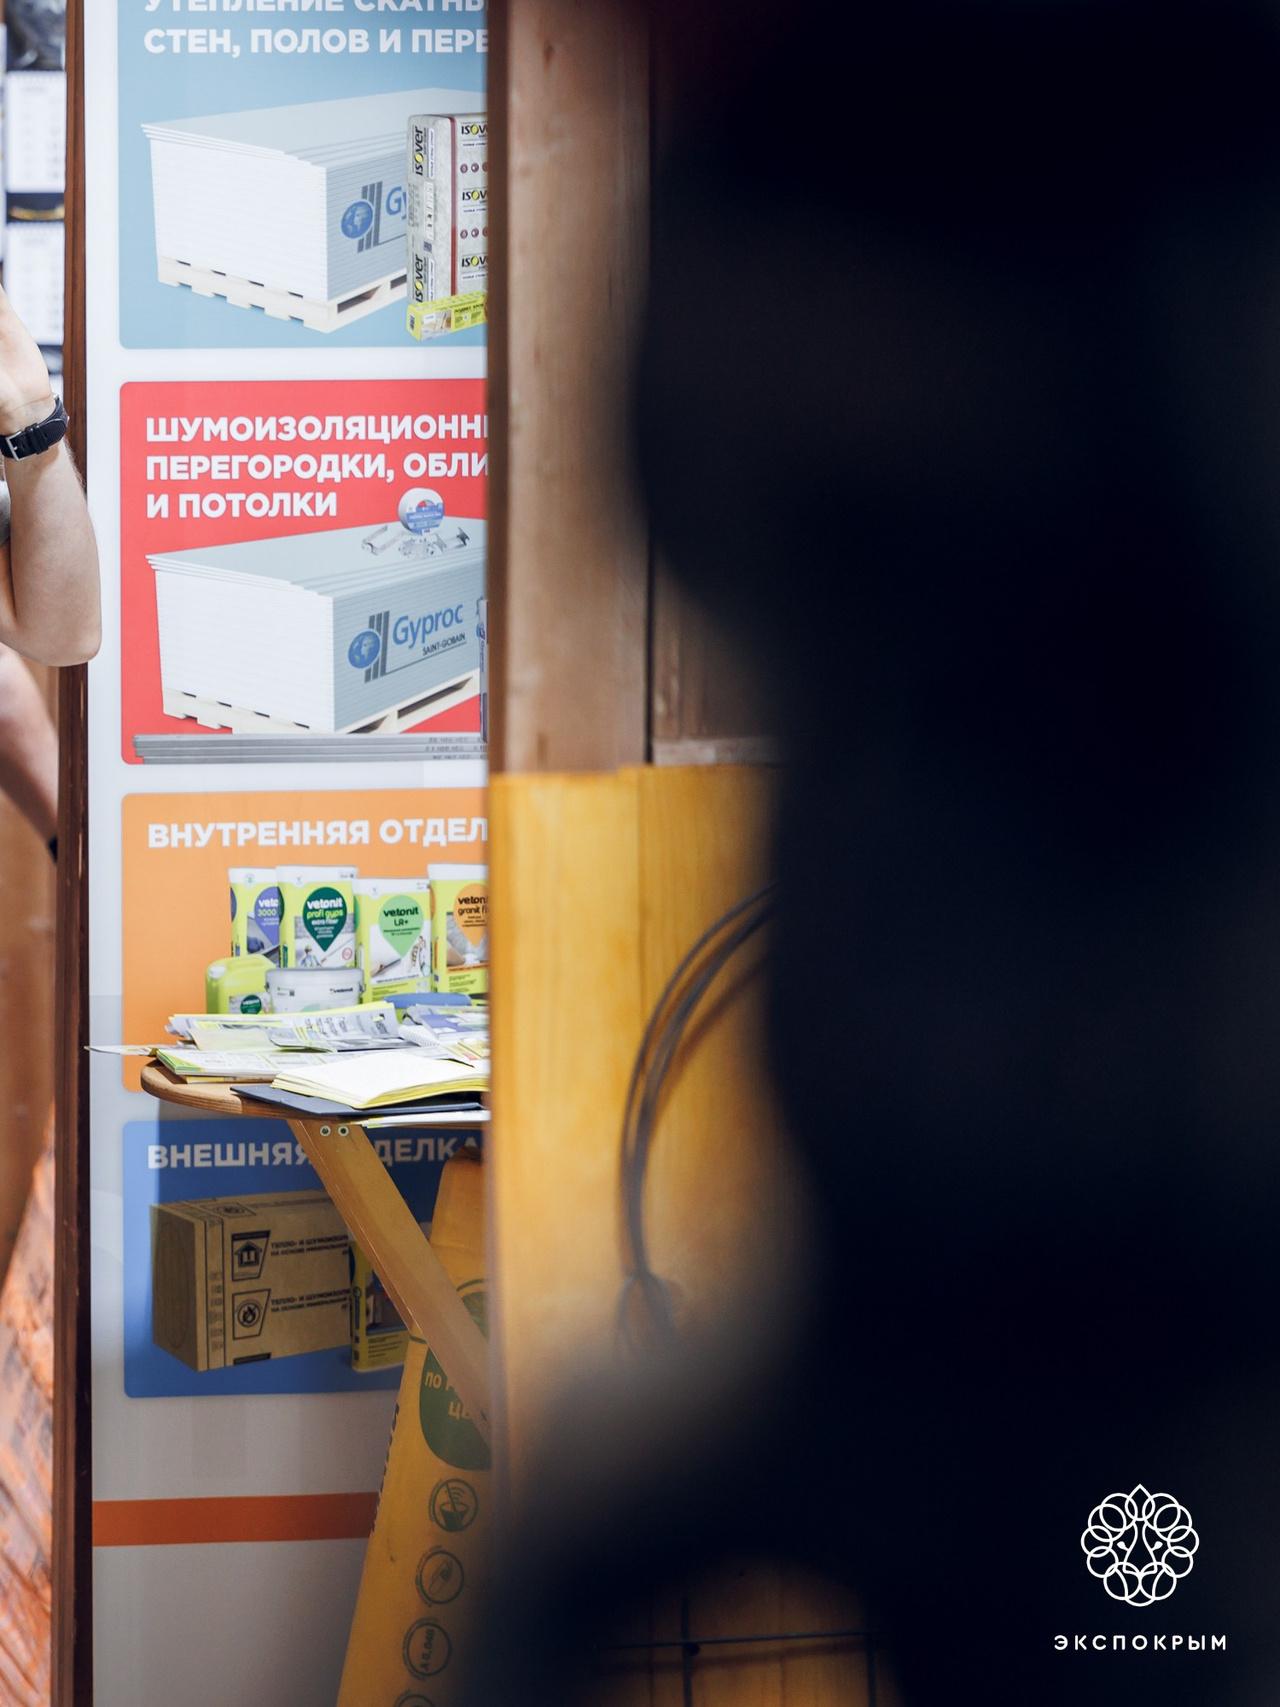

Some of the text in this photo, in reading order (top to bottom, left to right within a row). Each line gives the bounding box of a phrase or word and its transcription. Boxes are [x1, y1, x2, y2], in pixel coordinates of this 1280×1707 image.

[144, 28, 488, 58] СТЕН, ПОЛОВ И ПЕРЕ
[146, 414, 488, 444] ШУМОИЗОЛЯЦИОНН
[146, 452, 488, 483] ПЕРЕГОРОДКИ, ОБЛИ
[146, 492, 337, 518] И ПОТОЛКИ
[393, 604, 463, 649] Gyproc
[422, 632, 466, 656] SAINT-GOBAIN
[148, 817, 488, 849] ВНУТРЕННЯЯ ОТДЕЛ
[306, 897, 343, 910] vetonit
[383, 907, 419, 917] vetonit
[374, 1137, 478, 1167] ДЕЛК
